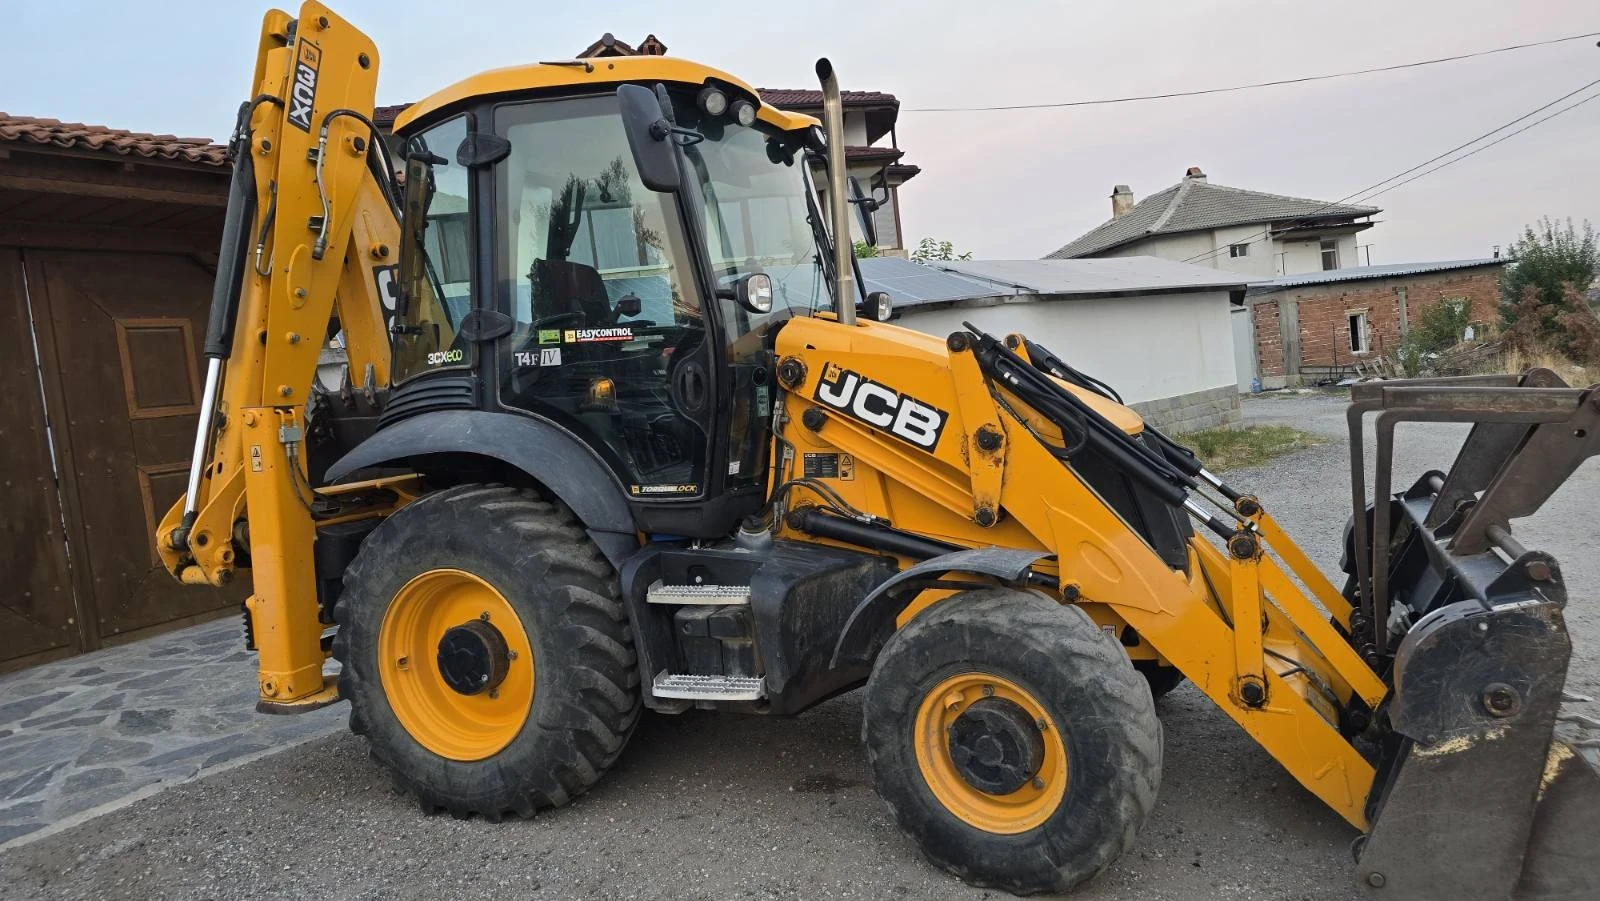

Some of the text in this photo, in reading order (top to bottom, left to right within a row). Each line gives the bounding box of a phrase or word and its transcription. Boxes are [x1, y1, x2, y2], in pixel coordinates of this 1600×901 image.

[290, 64, 316, 125] 3CX
[576, 328, 633, 340] EASYCONTROL
[427, 348, 463, 365] 3CXeco
[819, 373, 941, 447] JCB
[641, 485, 696, 493] TORQOCK
